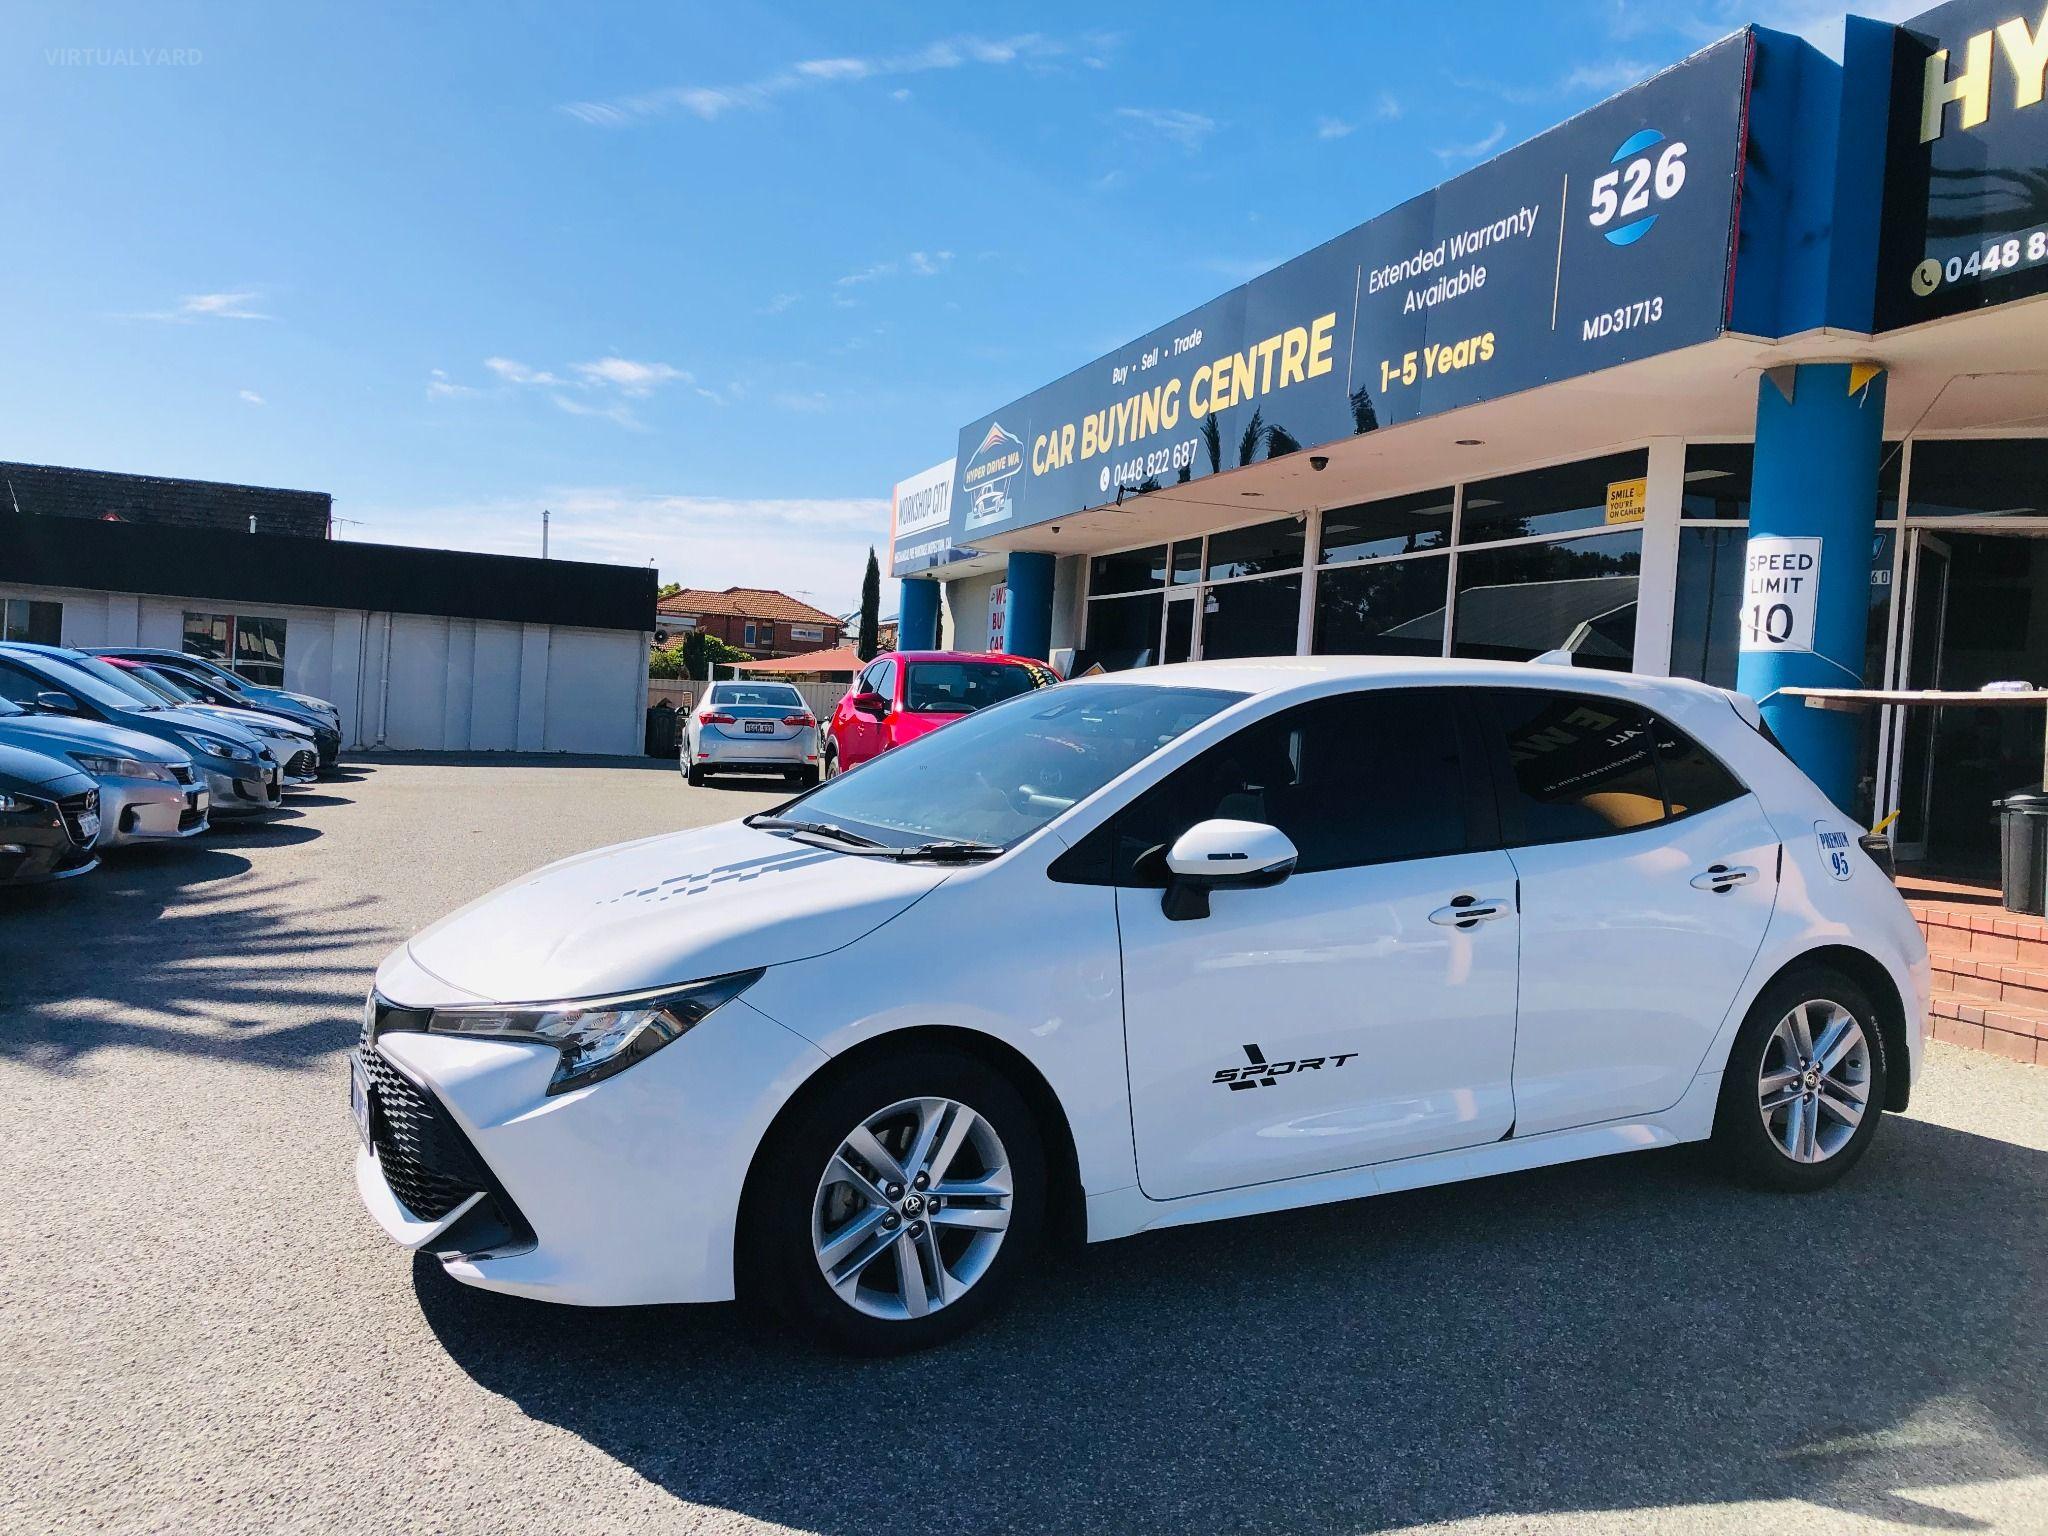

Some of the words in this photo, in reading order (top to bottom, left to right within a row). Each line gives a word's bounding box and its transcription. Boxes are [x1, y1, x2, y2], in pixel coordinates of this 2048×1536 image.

[1588, 142, 1688, 227] 526
[1369, 239, 1445, 294] Extended
[1449, 204, 1540, 261] Warranty
[1944, 239, 2020, 283] 0448
[1403, 265, 1487, 315] Available
[1582, 296, 1663, 341] MD31713
[1112, 365, 1129, 385] Buy
[1141, 347, 1158, 371] Sell
[1173, 328, 1203, 357] Trade
[1380, 351, 1417, 393] 1-5
[1423, 332, 1495, 378] Years
[1032, 422, 1076, 476] CAR
[1081, 378, 1181, 460] BUYING
[1189, 311, 1336, 420] CENTRE
[966, 465, 986, 483] HYPER
[986, 456, 1006, 475] DRIVE
[1008, 451, 1020, 467] WA
[1114, 455, 1144, 487] 0448
[1146, 448, 1169, 477] 822
[1173, 438, 1198, 469] 687
[933, 479, 950, 514] CITY
[1610, 500, 1633, 510] YOU'RE
[1611, 488, 1635, 500] SMILE
[1749, 553, 1813, 572] SPEED
[1751, 577, 1804, 594] LIMIT
[1753, 603, 1794, 643] 10
[1819, 832, 1850, 849] PREMIUM
[1831, 852, 1849, 875] 95
[1212, 1053, 1359, 1083] SPORT
